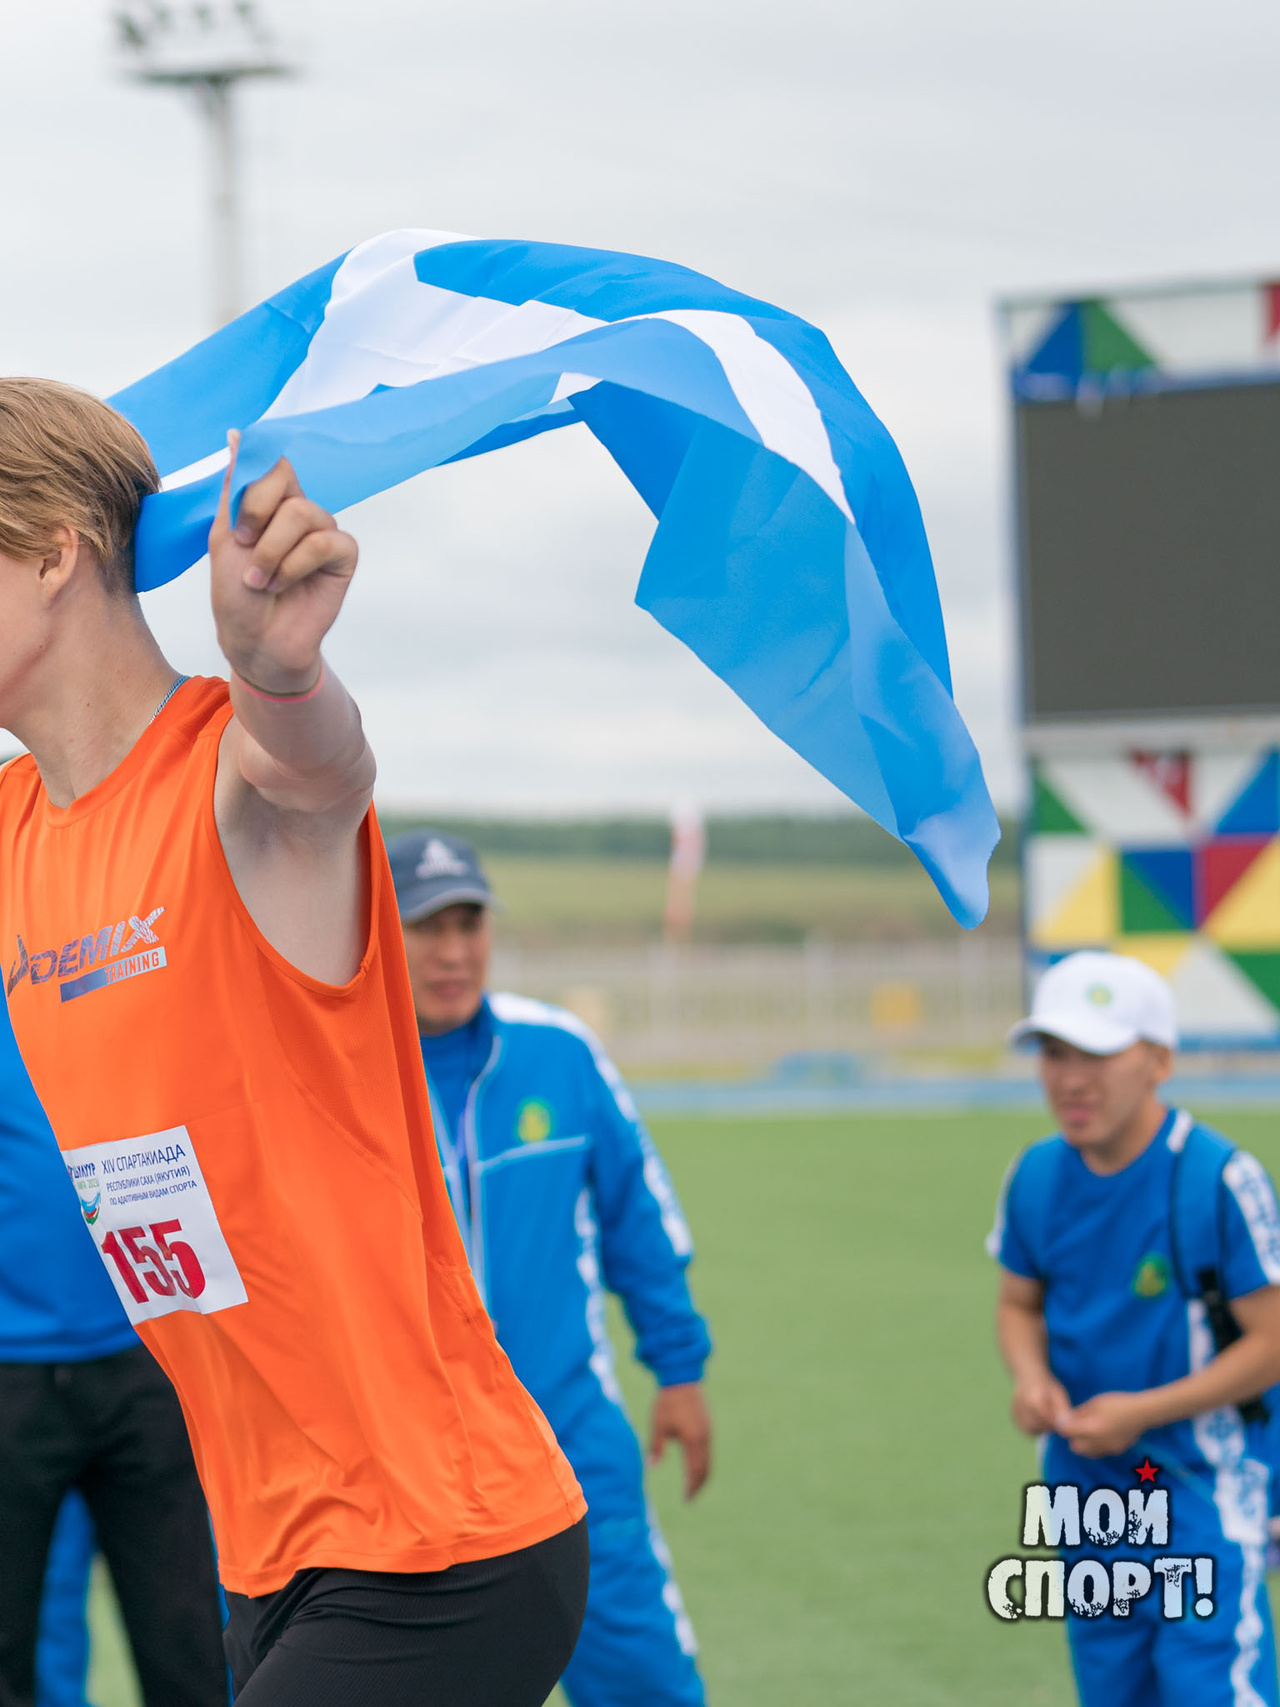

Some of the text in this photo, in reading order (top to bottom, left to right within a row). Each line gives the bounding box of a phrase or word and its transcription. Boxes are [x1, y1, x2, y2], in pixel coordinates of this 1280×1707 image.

[30, 906, 166, 985] DEMIX
[105, 951, 161, 984] TRAINING
[101, 1143, 187, 1175] XIV СПАРТАКИАДА
[106, 1164, 191, 1193] РЕСПУБЛИКИ САХА (ЯКУТИЯ)
[109, 1180, 198, 1206] ПО АДАПТИВНЫМ ВИДАМ СПОРТА
[101, 1218, 206, 1304] 155
